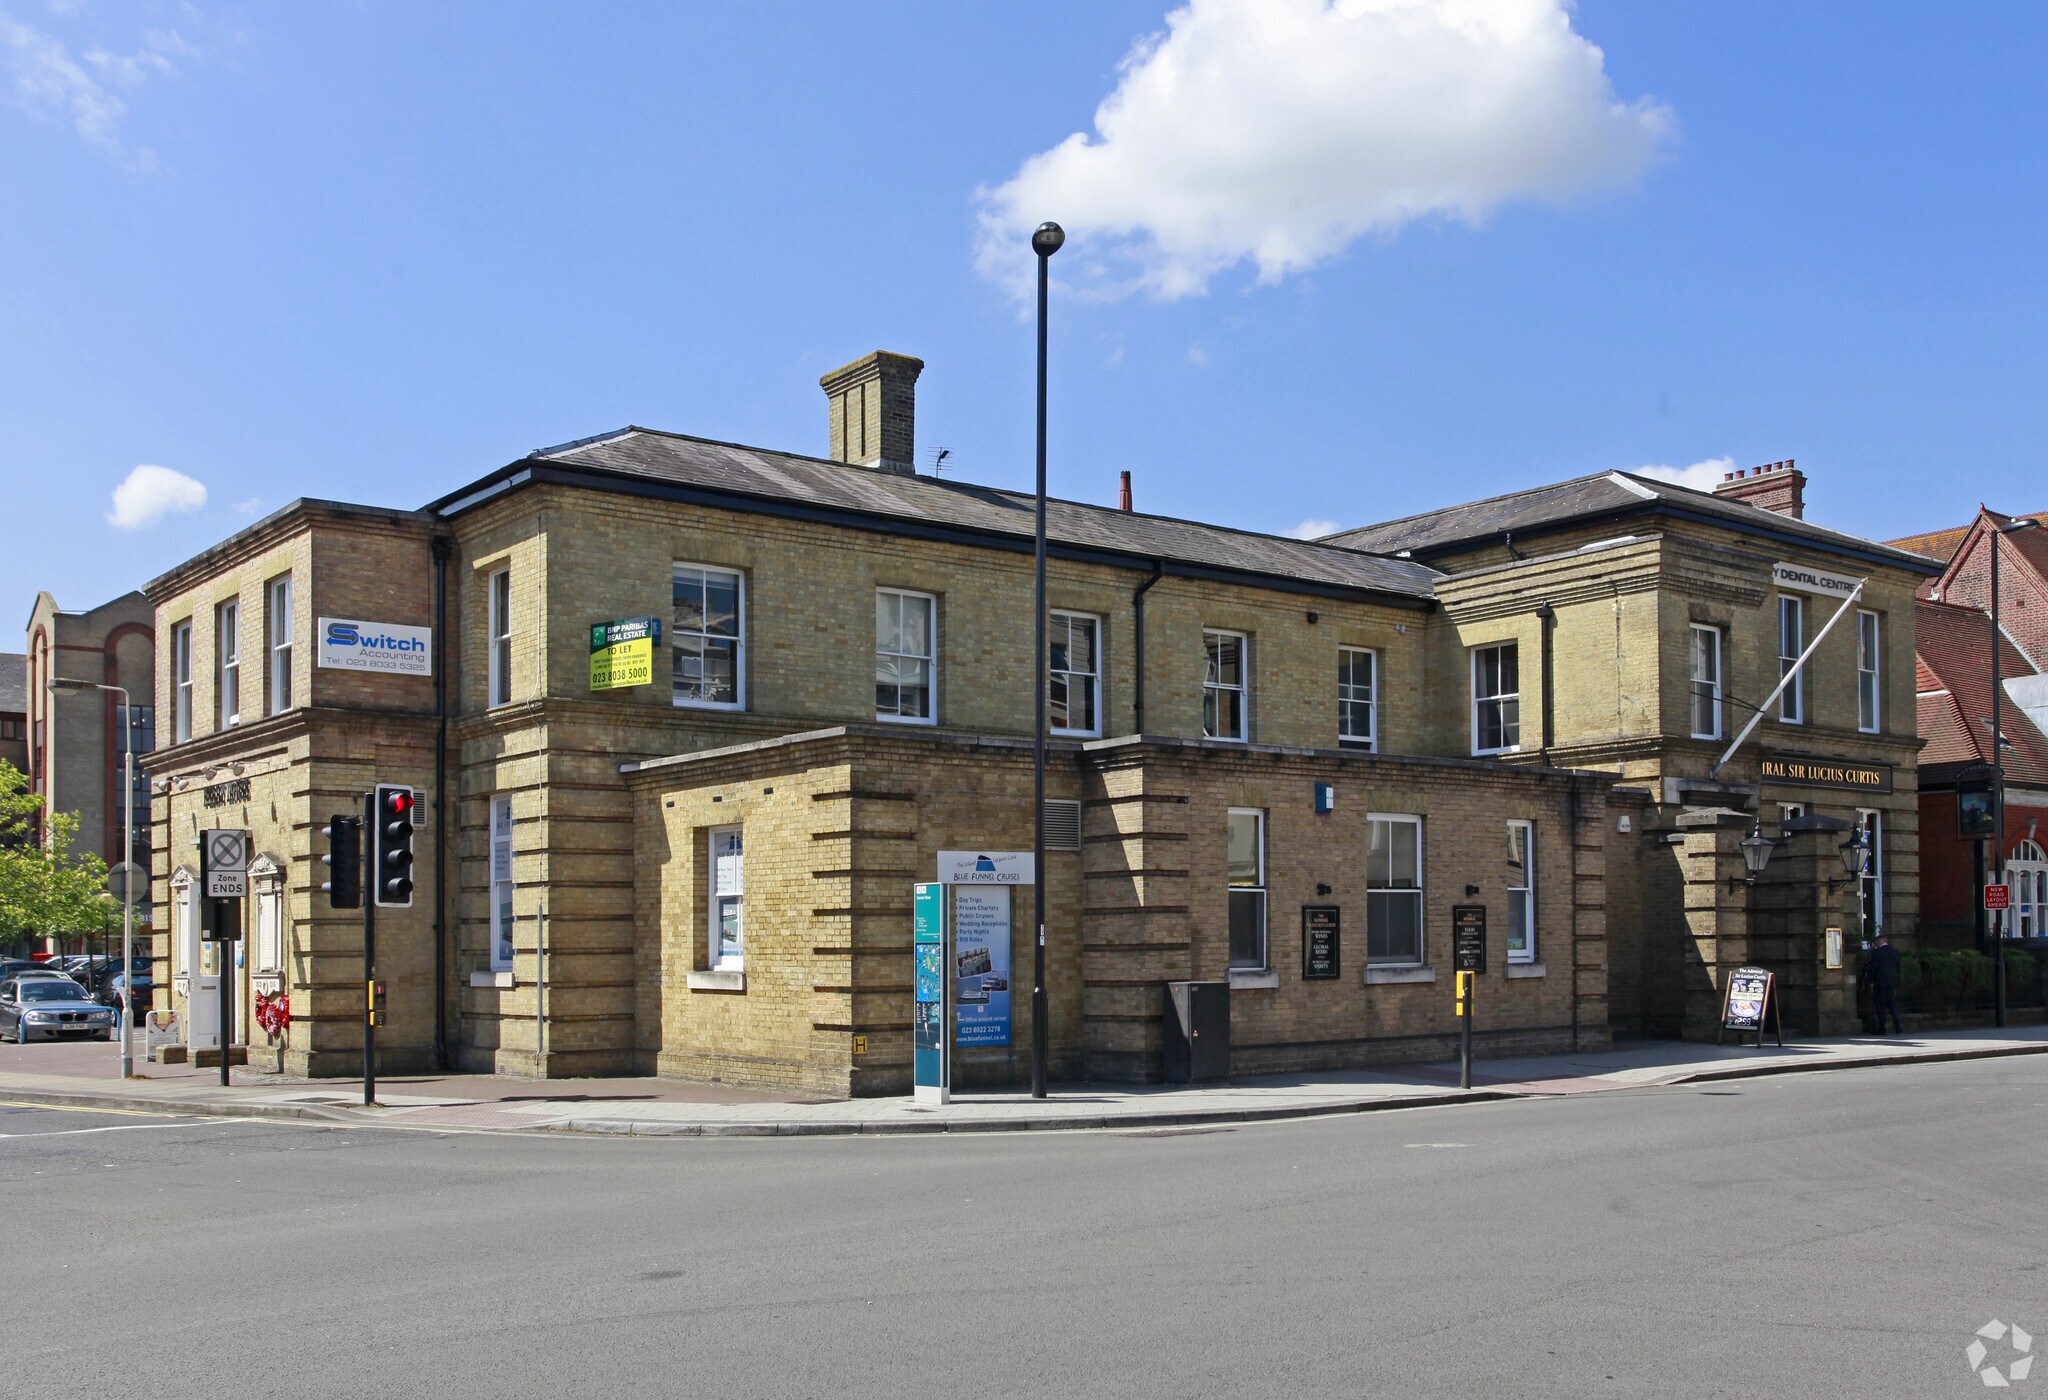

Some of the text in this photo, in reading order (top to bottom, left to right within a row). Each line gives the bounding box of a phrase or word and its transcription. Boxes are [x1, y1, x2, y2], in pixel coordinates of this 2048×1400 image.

[1781, 569, 1819, 586] DENTAL
[1820, 578, 1855, 593] CENTRE
[607, 625, 620, 634] BNP
[621, 621, 649, 632] PARIBAS
[326, 622, 425, 652] Switch
[607, 629, 647, 642] REAL ESTATE
[360, 649, 425, 663] Accounting
[607, 645, 632, 655] TO LET
[346, 658, 367, 667] 023
[370, 660, 397, 669] 8033
[400, 663, 426, 672] 5325
[592, 666, 648, 684] 023 8038 5000
[1789, 764, 1805, 778] SIR
[1808, 766, 1844, 782] LUCIUS
[1845, 769, 1880, 785] CURTIS
[953, 873, 1020, 882] BLUE FUNNEL CRUISES
[212, 884, 243, 893] ENDS
[856, 1038, 866, 1052] H
